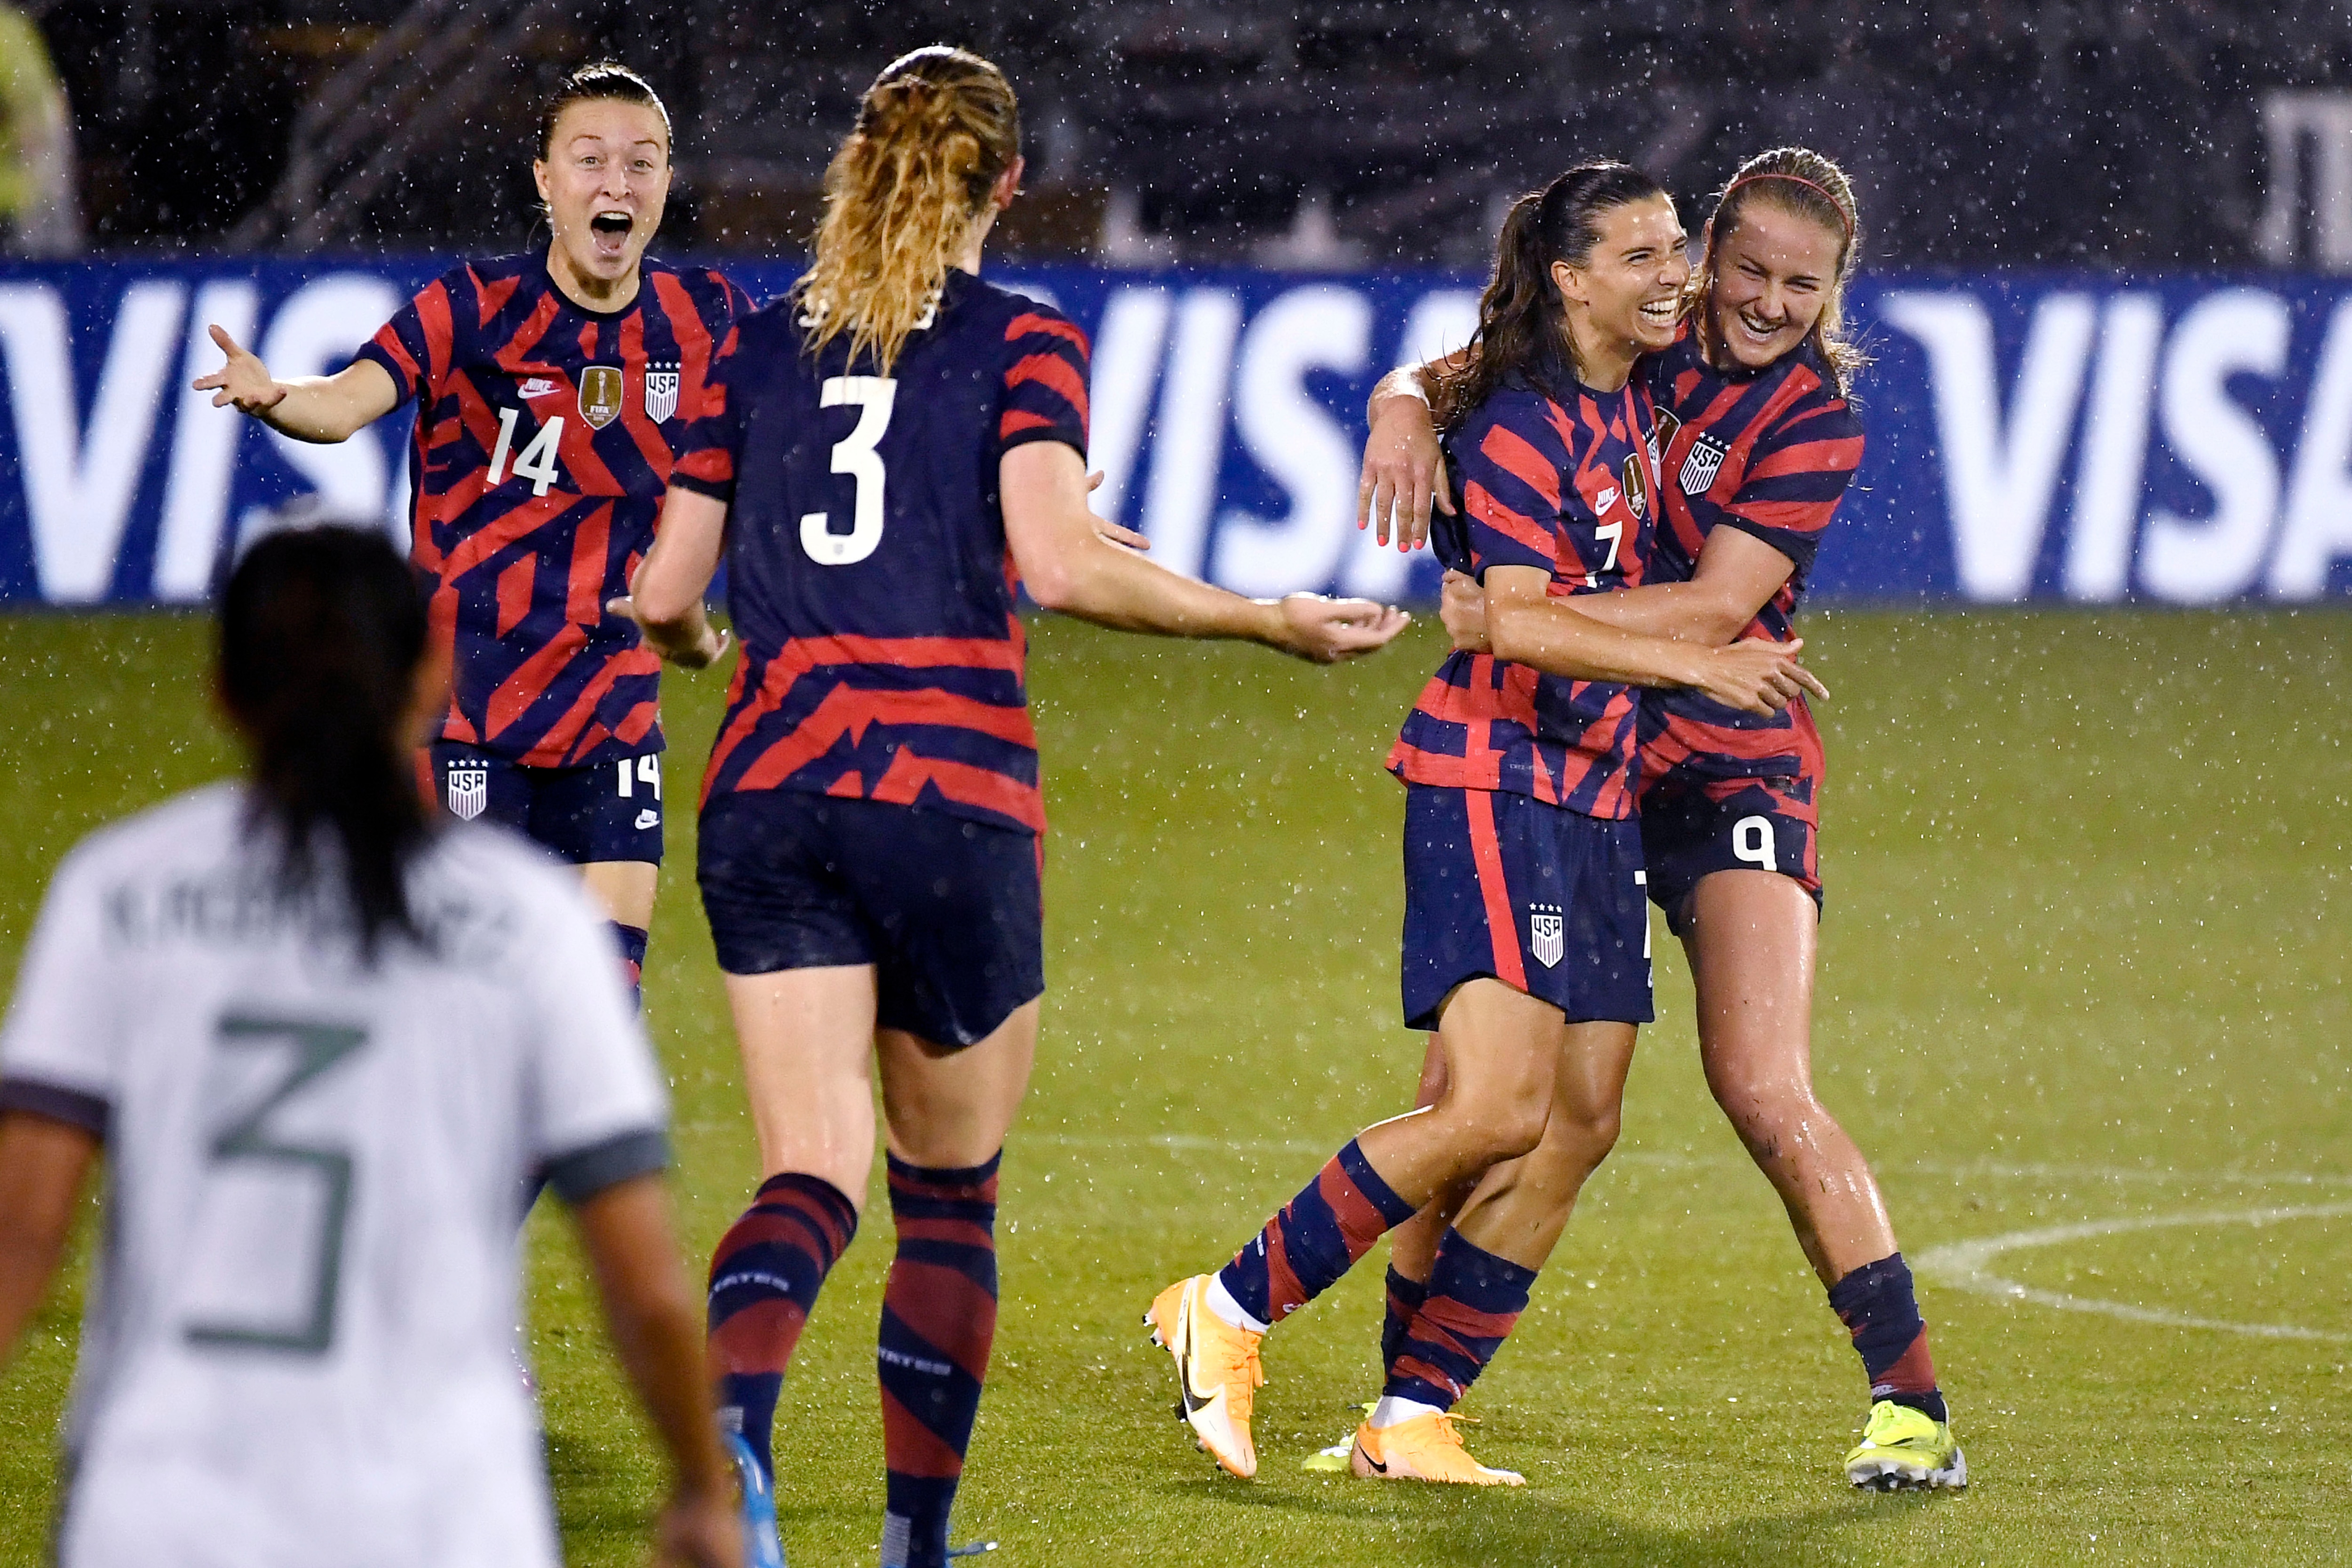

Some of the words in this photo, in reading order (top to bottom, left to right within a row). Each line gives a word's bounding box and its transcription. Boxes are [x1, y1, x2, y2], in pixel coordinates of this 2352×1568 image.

[524, 377, 553, 391] NIKE
[648, 375, 676, 394] USA
[590, 405, 609, 414] FIFA
[0, 279, 414, 606] VIS
[486, 406, 564, 497] 14
[1692, 444, 1722, 468] USA
[799, 375, 898, 565] 3
[1597, 486, 1615, 505] NIKE
[1585, 520, 1622, 589] 7
[451, 773, 484, 792] USA
[618, 753, 660, 801] 14
[1732, 815, 1777, 871] 9
[1534, 917, 1560, 938] USA
[181, 1009, 373, 1355] 3
